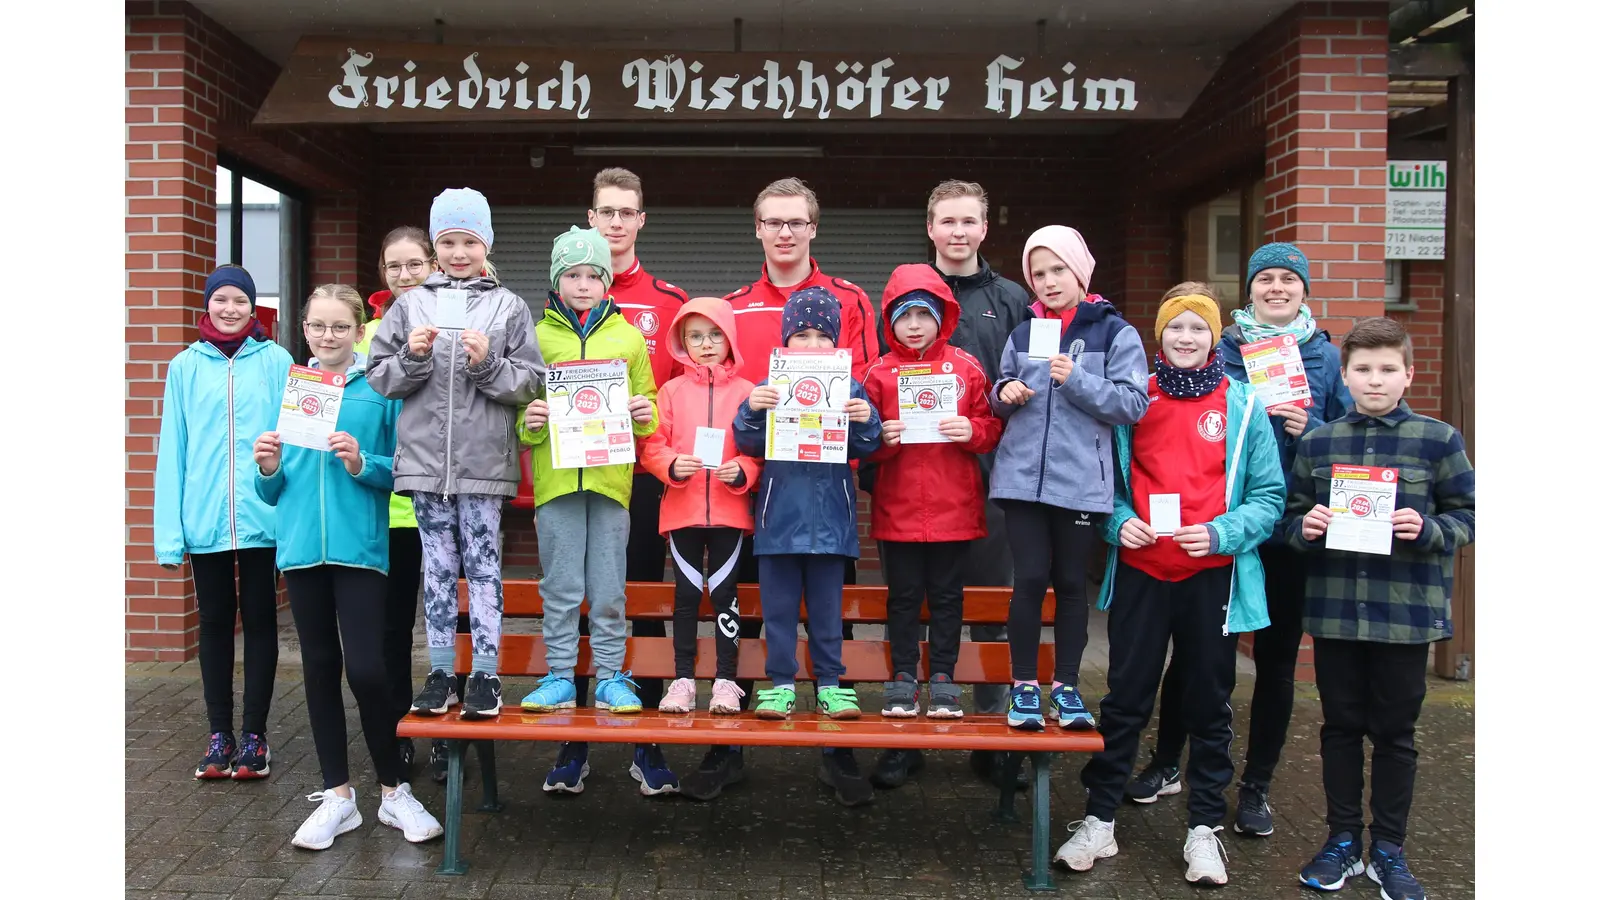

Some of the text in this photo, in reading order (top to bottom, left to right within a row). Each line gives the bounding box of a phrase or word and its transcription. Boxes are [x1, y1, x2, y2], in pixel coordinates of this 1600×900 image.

[328, 47, 1139, 120] Friedrich Wischhöfer Heim
[1388, 233, 1406, 243] 712
[1395, 246, 1406, 255] 21
[1418, 247, 1430, 255] 22
[773, 359, 790, 370] 37.
[548, 370, 566, 381] 37.
[899, 377, 913, 385] 37.
[800, 383, 819, 393] 29.04.
[796, 389, 818, 402] 2023
[302, 402, 317, 413] 2023
[576, 400, 598, 410] 2023
[1333, 479, 1347, 488] 37.
[1351, 504, 1369, 513] 2023
